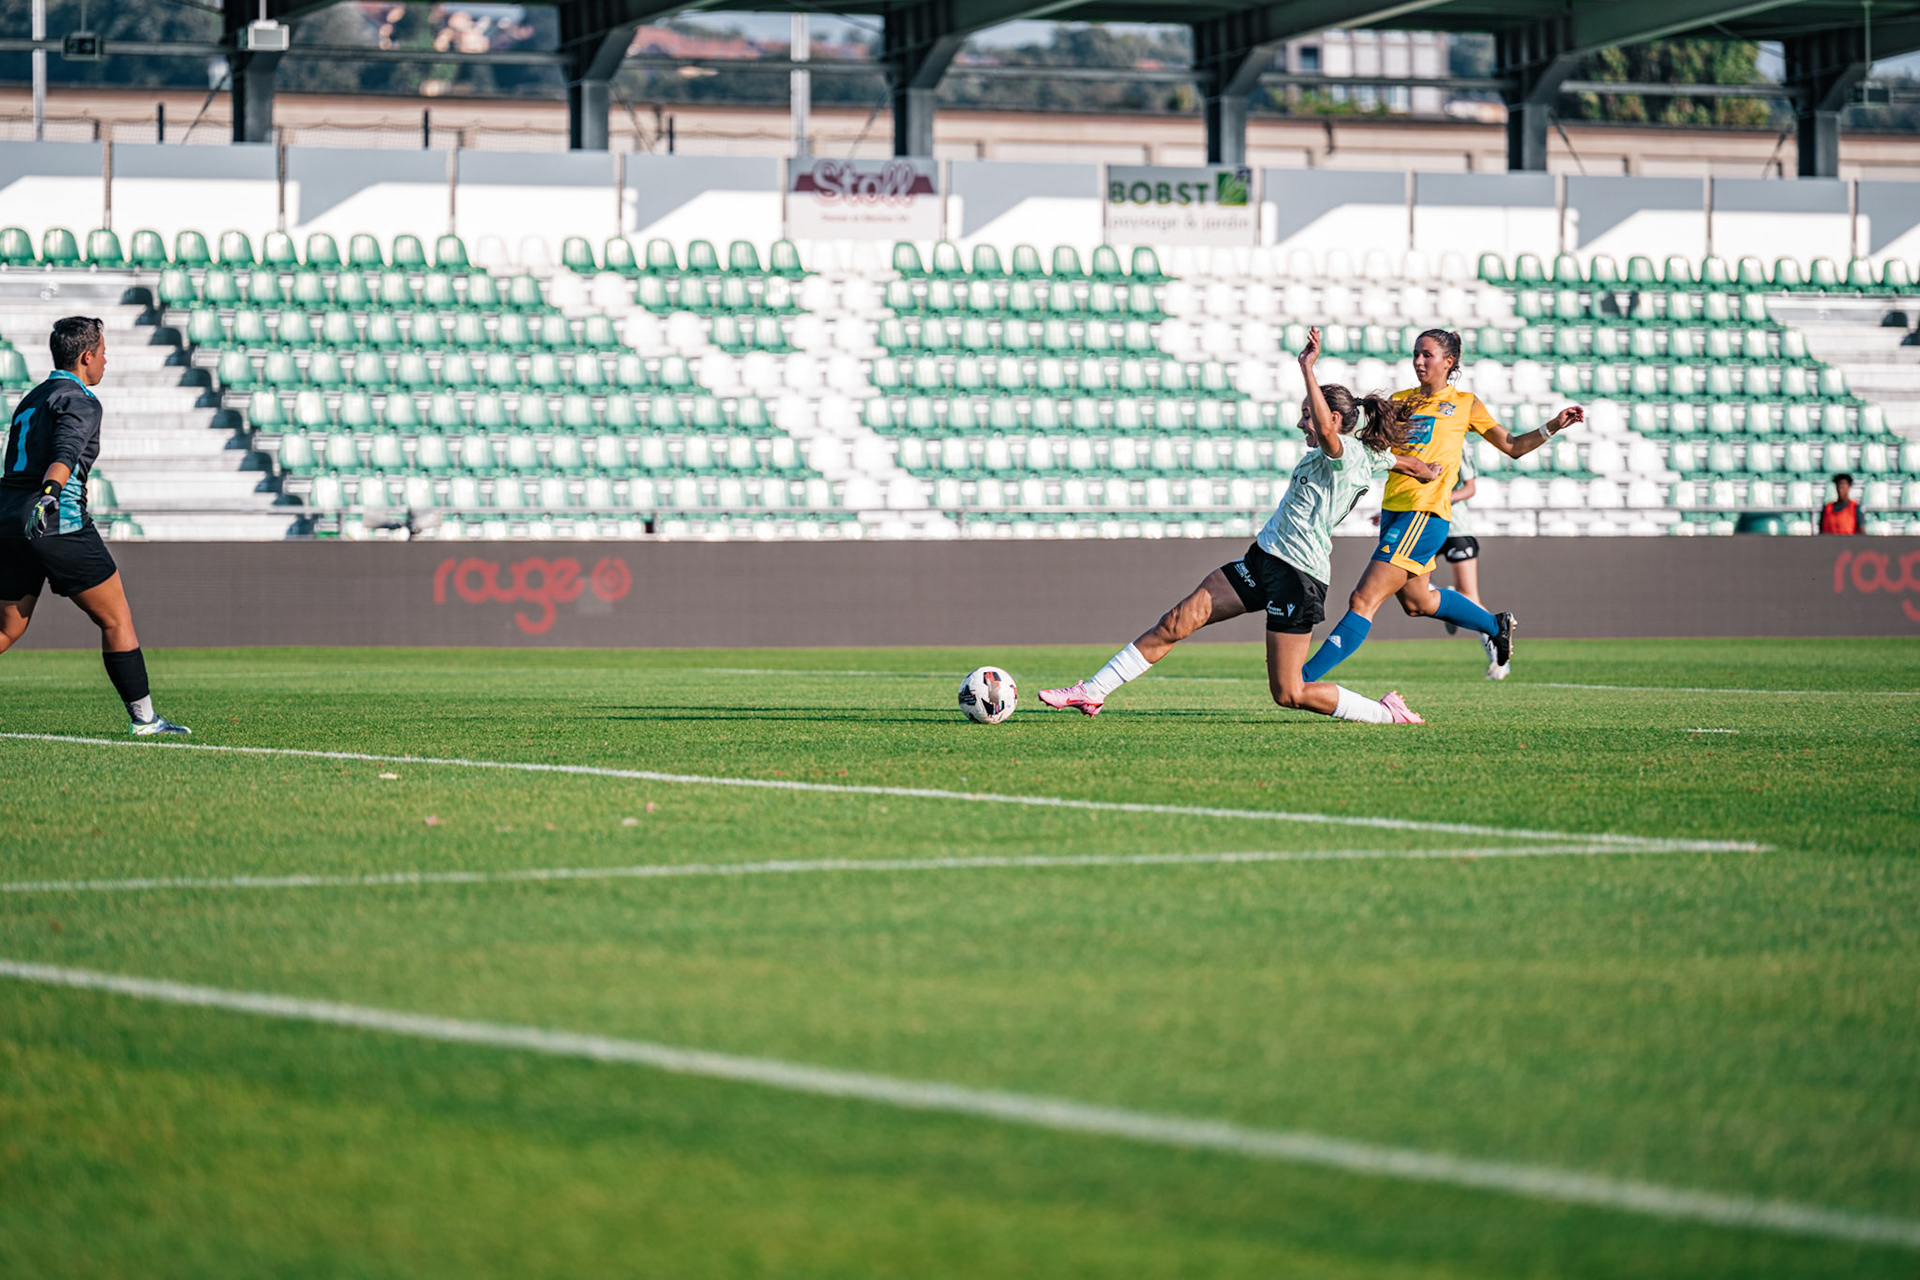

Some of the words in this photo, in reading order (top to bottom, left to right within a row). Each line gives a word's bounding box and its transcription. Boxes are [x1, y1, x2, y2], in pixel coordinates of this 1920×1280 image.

[812, 158, 917, 207] Stoll
[1110, 181, 1209, 205] BOBST
[13, 407, 36, 471] 1
[433, 556, 586, 635] rouge
